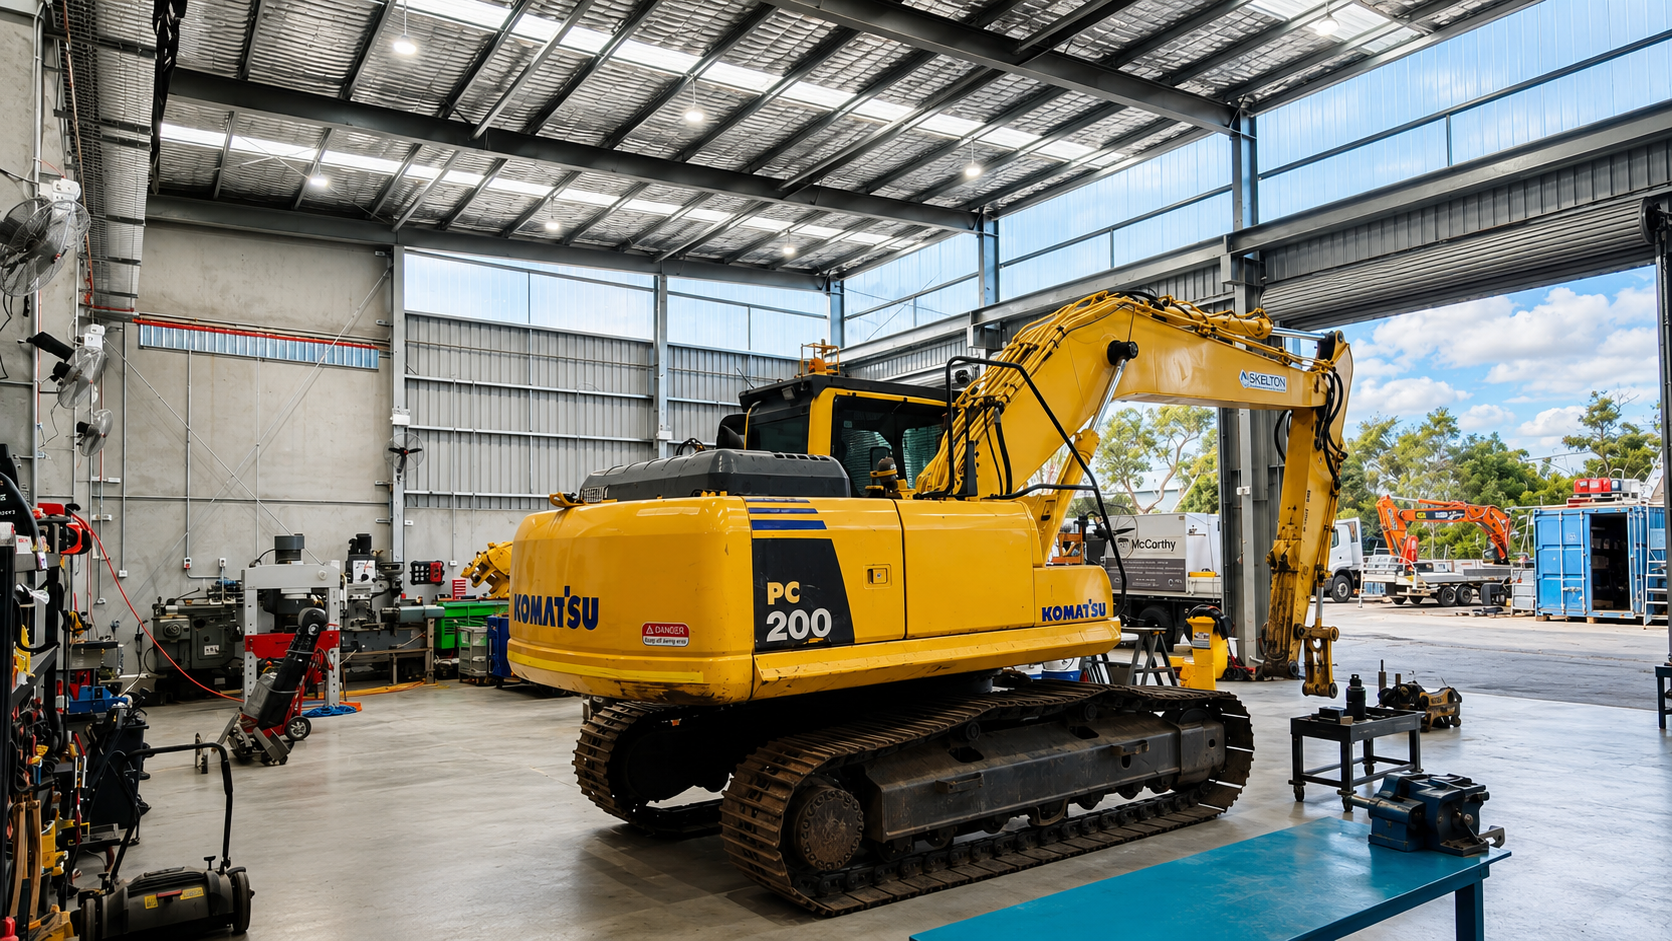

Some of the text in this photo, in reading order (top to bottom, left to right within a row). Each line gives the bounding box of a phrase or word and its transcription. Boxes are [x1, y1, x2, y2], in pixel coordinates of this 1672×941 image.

[1249, 372, 1286, 388] SKELTON
[767, 581, 800, 605] PC
[514, 585, 599, 631] KOMATSU
[1042, 598, 1106, 622] KOMATSU
[655, 625, 685, 635] DANGER
[766, 608, 832, 642] 200
